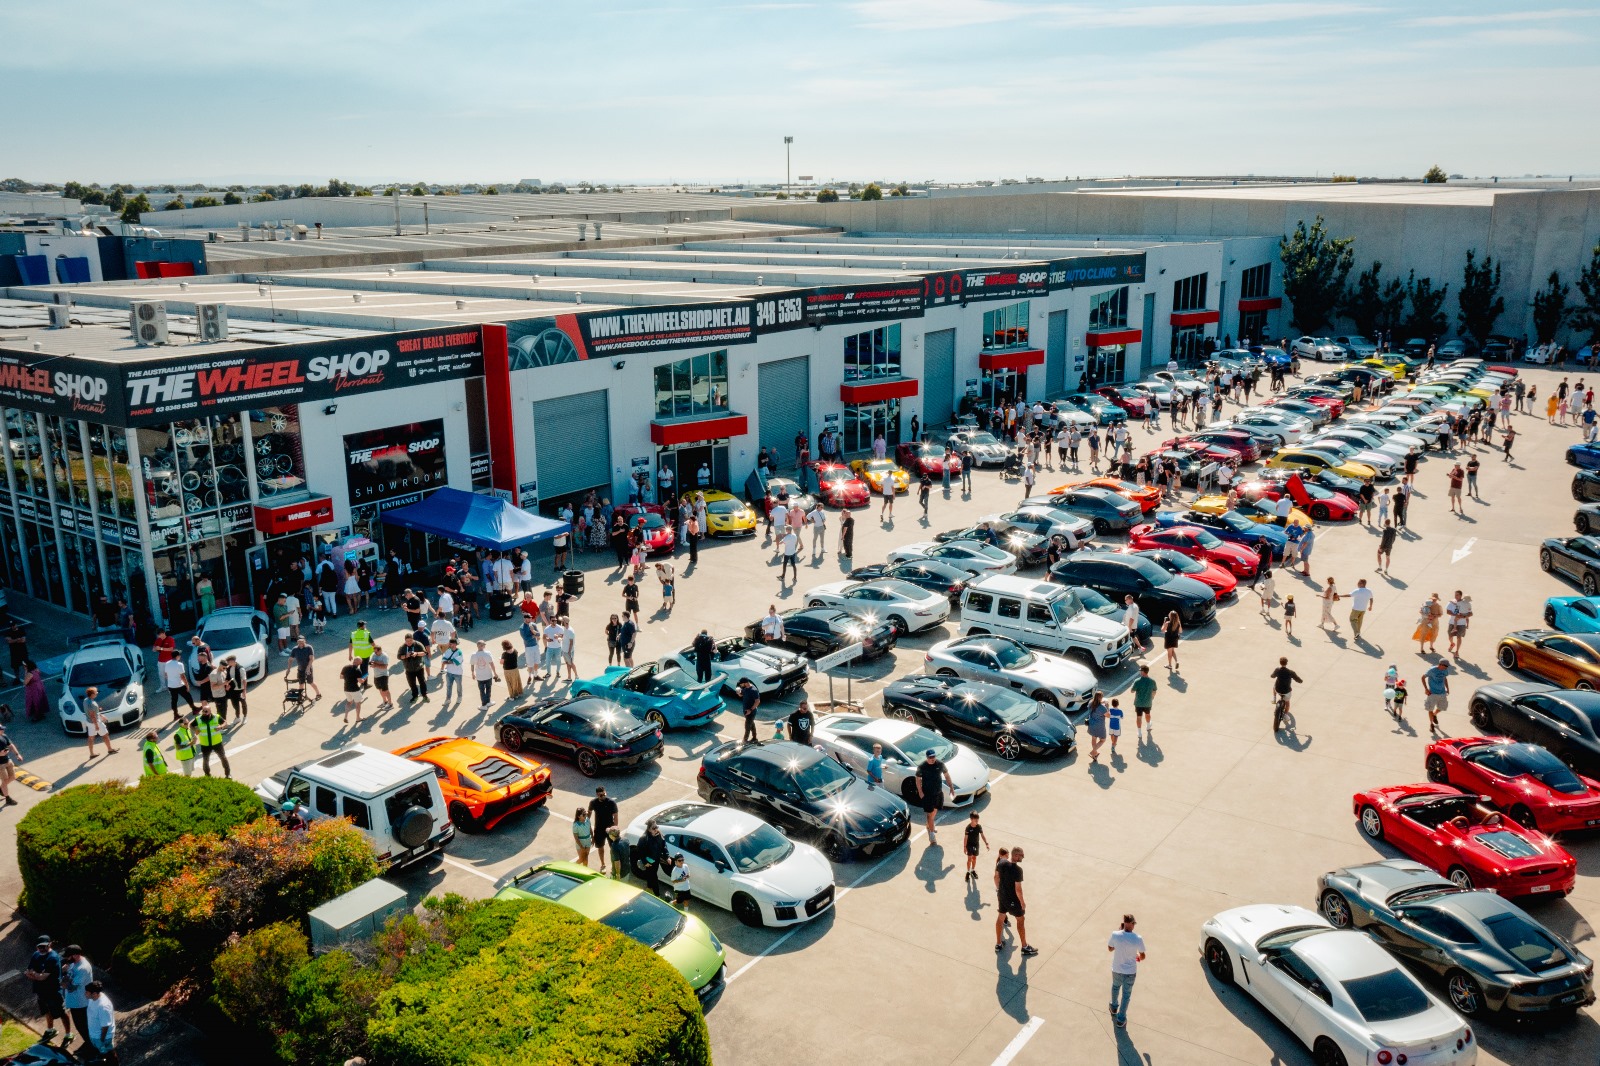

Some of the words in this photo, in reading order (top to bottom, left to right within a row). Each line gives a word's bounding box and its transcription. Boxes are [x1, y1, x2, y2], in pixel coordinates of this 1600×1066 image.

[966, 275, 986, 288] THE
[985, 273, 1019, 286] WHEEL
[1018, 272, 1048, 284] SHOP
[1066, 267, 1087, 282] AUTO
[1087, 266, 1117, 280] CLINIC
[818, 293, 845, 302] BRANDS
[845, 292, 855, 300] AT
[854, 290, 895, 299] AFFORDABLE
[778, 297, 802, 324] 5353
[589, 306, 750, 339] WWW.THEWHEELSHOP.NET.AU
[422, 335, 445, 350] DEALS
[595, 331, 752, 352] WWW.FACEBOOK.COM/THEWHEELSHOPDERRIMUT
[126, 372, 197, 406] THE
[197, 359, 305, 396] WHEEL
[306, 349, 390, 382] SHOP
[142, 365, 187, 377] AUSTRALIAN
[187, 362, 211, 371] WHEEL
[211, 358, 246, 368] COMPANY
[0, 364, 54, 394] WHEEL
[54, 371, 108, 402] SHOP
[201, 398, 217, 406] WEB
[217, 387, 304, 404] WWW.THEWHEELSHOP.NET.AU
[130, 408, 154, 416] PHONE
[165, 403, 181, 412] 8348
[181, 401, 198, 410] 5353
[350, 450, 373, 465] THE
[408, 438, 440, 453] SHOP
[144, 456, 153, 480] SHOP
[355, 471, 443, 498] SHOWROOM
[382, 495, 419, 510] ENTRANCE
[287, 511, 311, 521] WHEEL
[156, 572, 165, 595] SHOP
